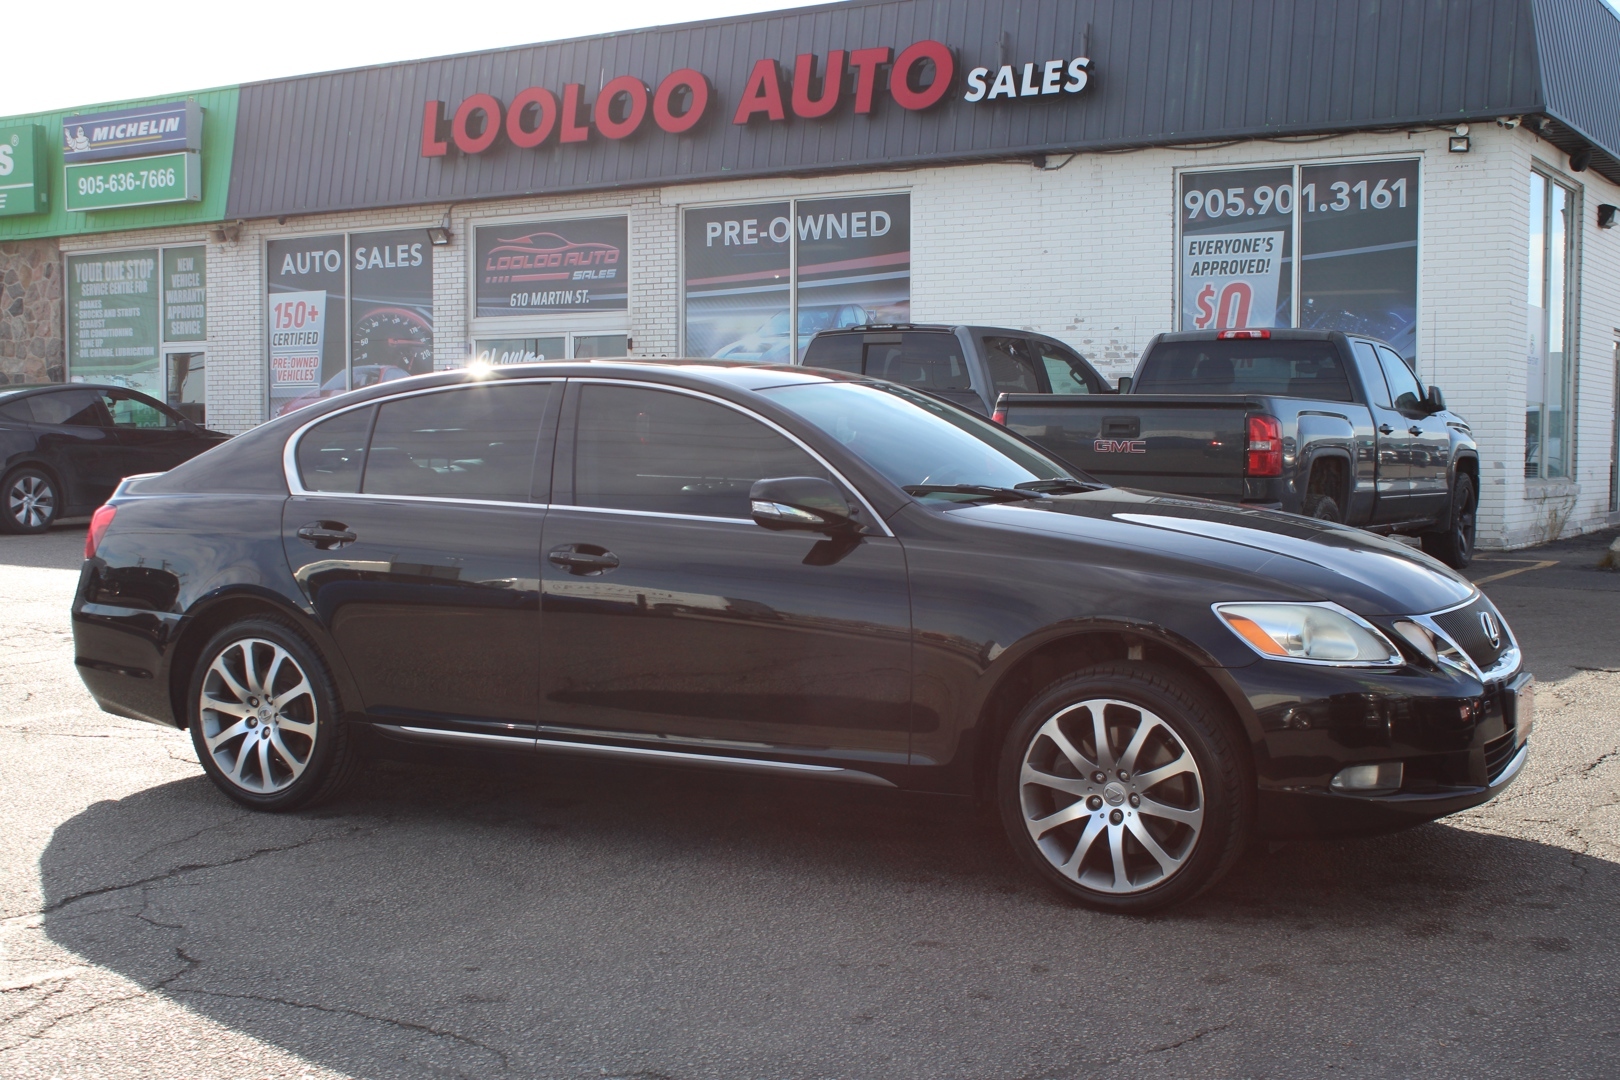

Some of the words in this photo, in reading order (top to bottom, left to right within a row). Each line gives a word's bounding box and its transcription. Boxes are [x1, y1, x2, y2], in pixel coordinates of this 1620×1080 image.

[422, 68, 708, 158] LOOLOO
[732, 40, 954, 125] AUTO
[964, 56, 1090, 103] SALES
[92, 116, 180, 142] MICHELIN
[78, 167, 175, 196] 905-636-7666
[1184, 178, 1407, 220] 905.901.3161
[706, 210, 892, 247] PRE-OWNED
[1188, 236, 1274, 256] EVERYONE'S
[177, 257, 194, 271] NEW
[281, 250, 341, 275] AUTO
[355, 243, 422, 270] SALES
[486, 253, 562, 271] LOOLOO
[564, 250, 620, 266] AUTO
[74, 262, 102, 283] YOUR
[105, 260, 124, 281] ONE
[126, 258, 154, 279] STOP
[572, 268, 617, 281] SALES
[1190, 258, 1271, 277] APPROVED!
[81, 283, 108, 296] SERVICE
[134, 281, 148, 293] FOR
[172, 273, 200, 288] VEHICLE
[166, 288, 206, 304] WARRANTY
[510, 292, 528, 307] 610
[530, 290, 573, 306] MARTIN
[575, 289, 589, 304] ST.
[117, 307, 140, 316] STRUTS
[167, 305, 204, 320] APPROVED
[274, 301, 319, 329] 150+
[79, 330, 90, 338] AIR
[90, 328, 133, 338] CONDITIONING
[171, 320, 200, 335] SERVICE
[272, 331, 319, 346] CERTIFIED
[272, 356, 318, 369] PRE-OWNED
[276, 369, 314, 382] VEHICLES
[1094, 439, 1146, 454] GMC
